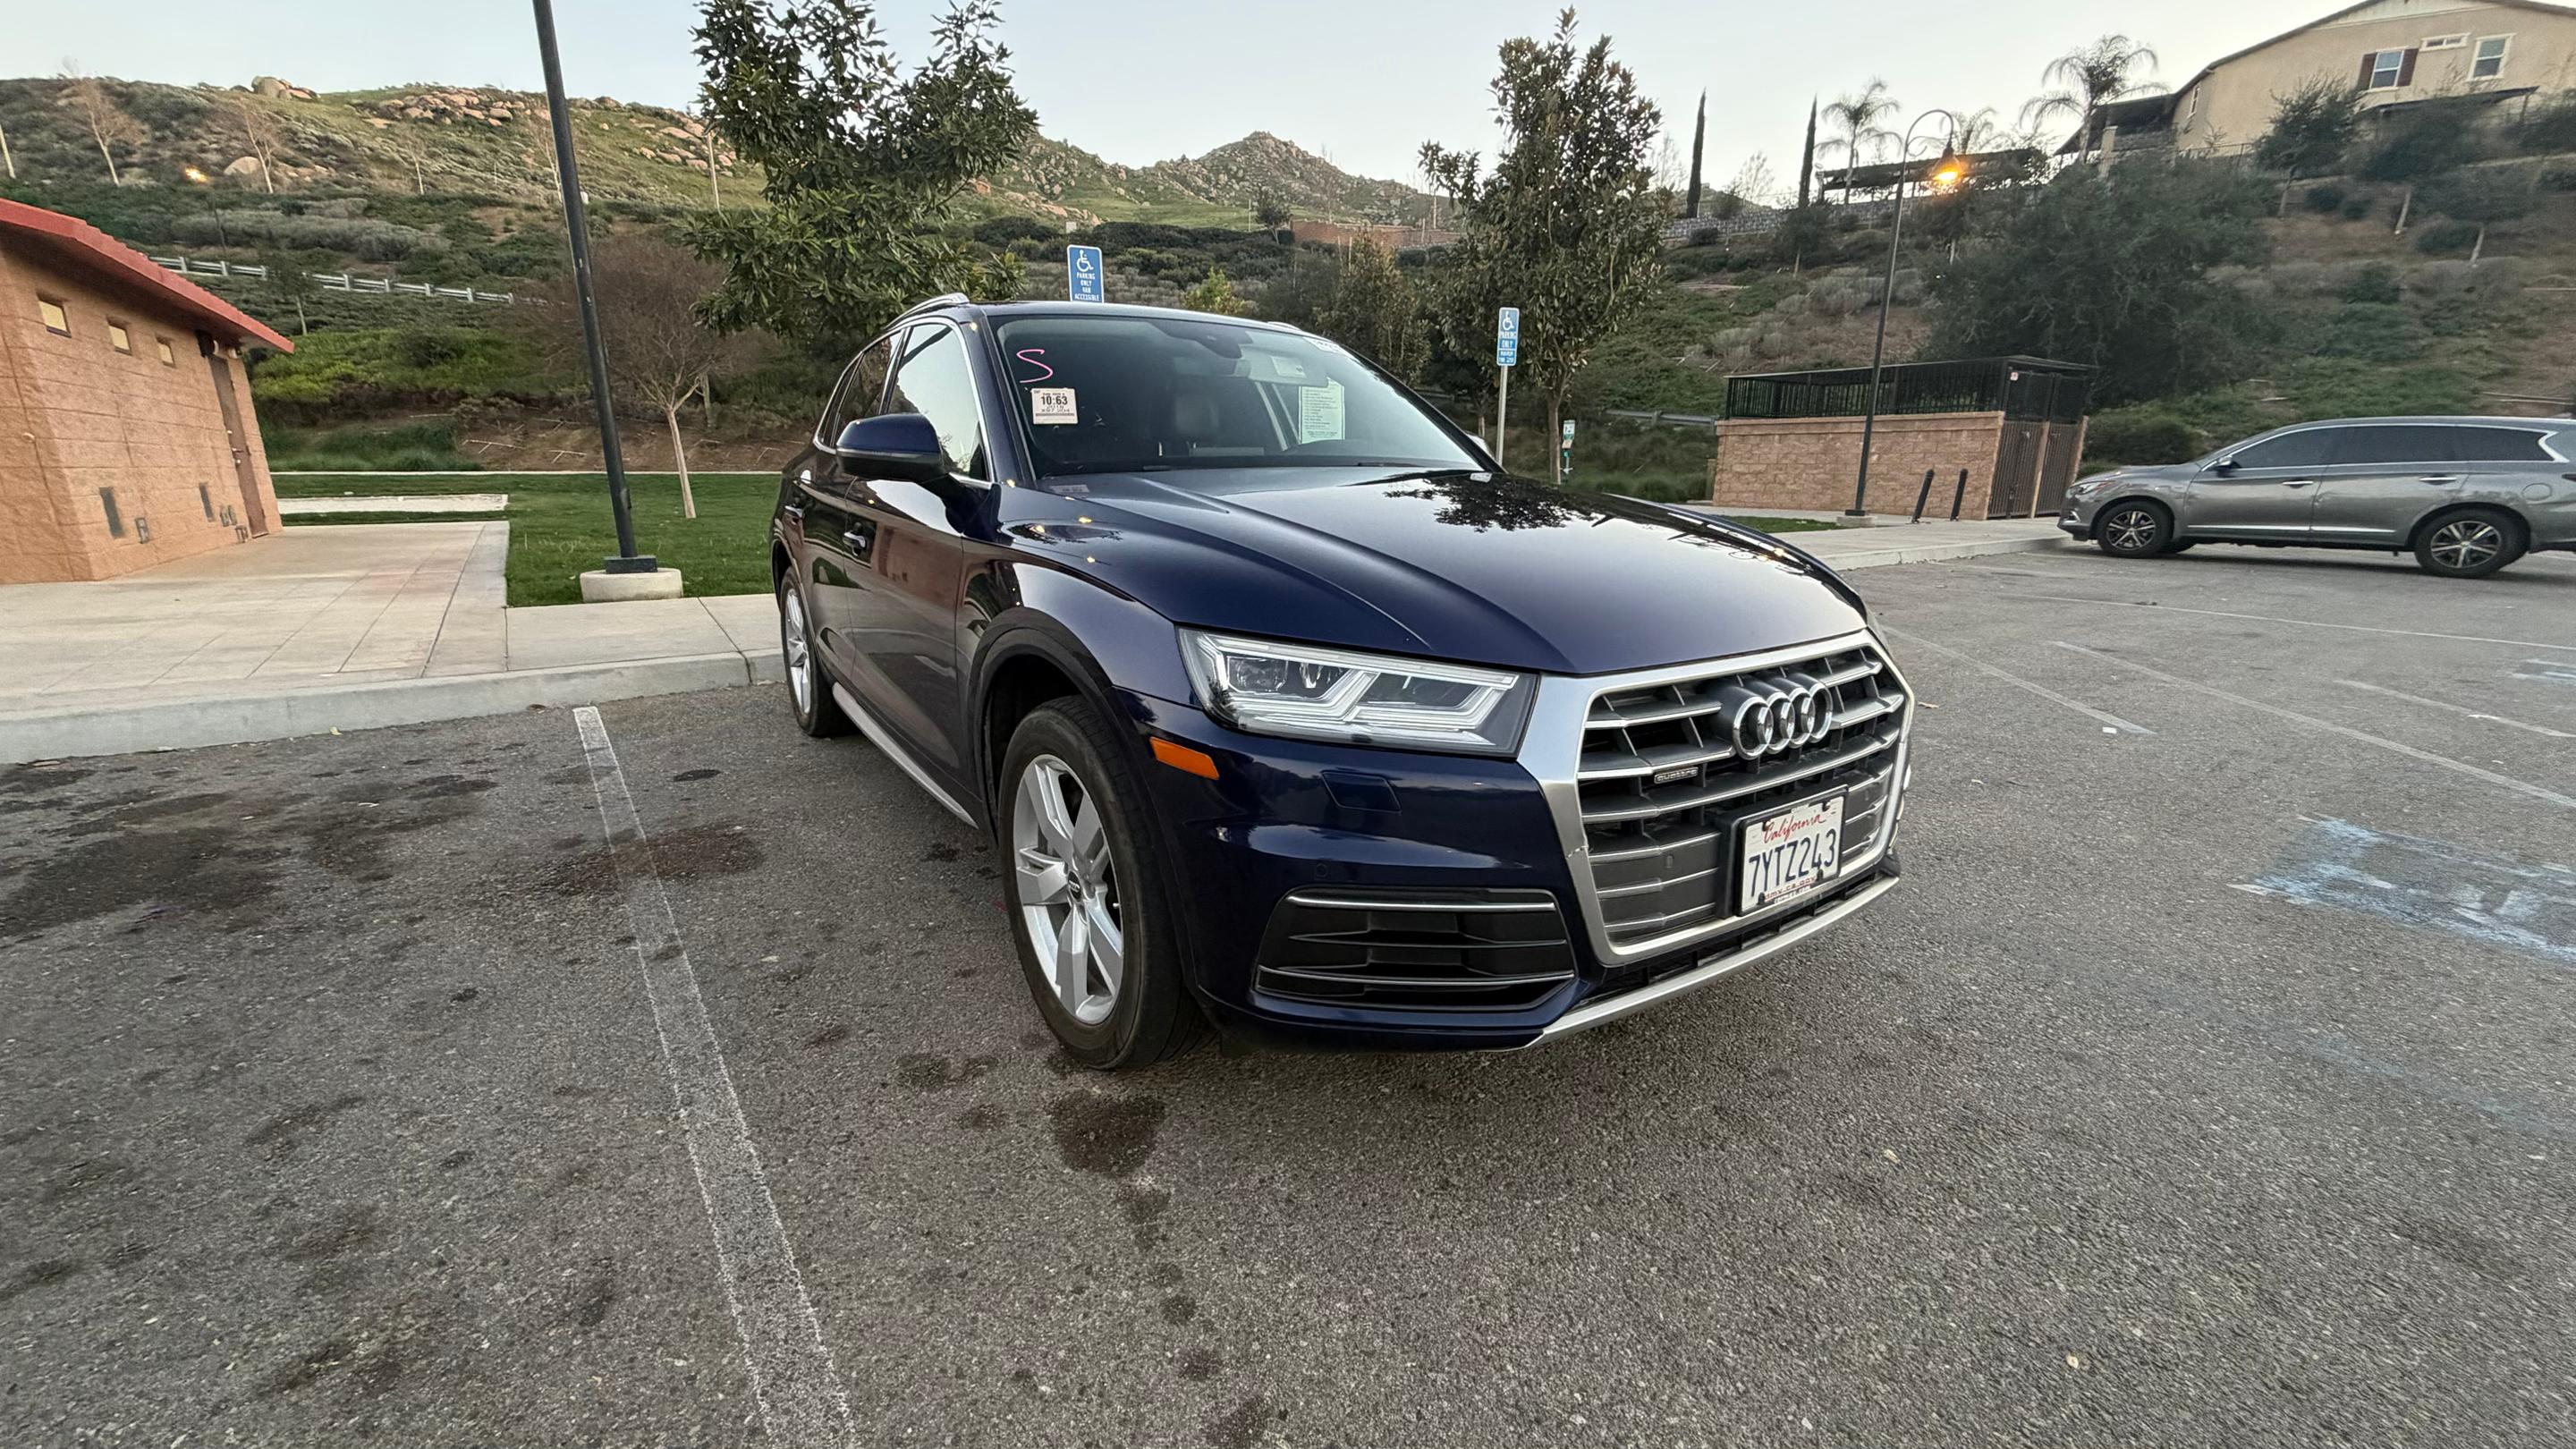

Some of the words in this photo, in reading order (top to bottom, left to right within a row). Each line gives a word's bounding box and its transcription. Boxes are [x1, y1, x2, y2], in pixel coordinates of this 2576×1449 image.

[1076, 272, 1096, 280] PARKING
[1074, 293, 1100, 301] ACCESSIBLE
[1016, 349, 1054, 383] S
[1657, 768, 1698, 782] quattro
[1763, 813, 1826, 843] California
[1749, 828, 1836, 897] 7YTZ243
